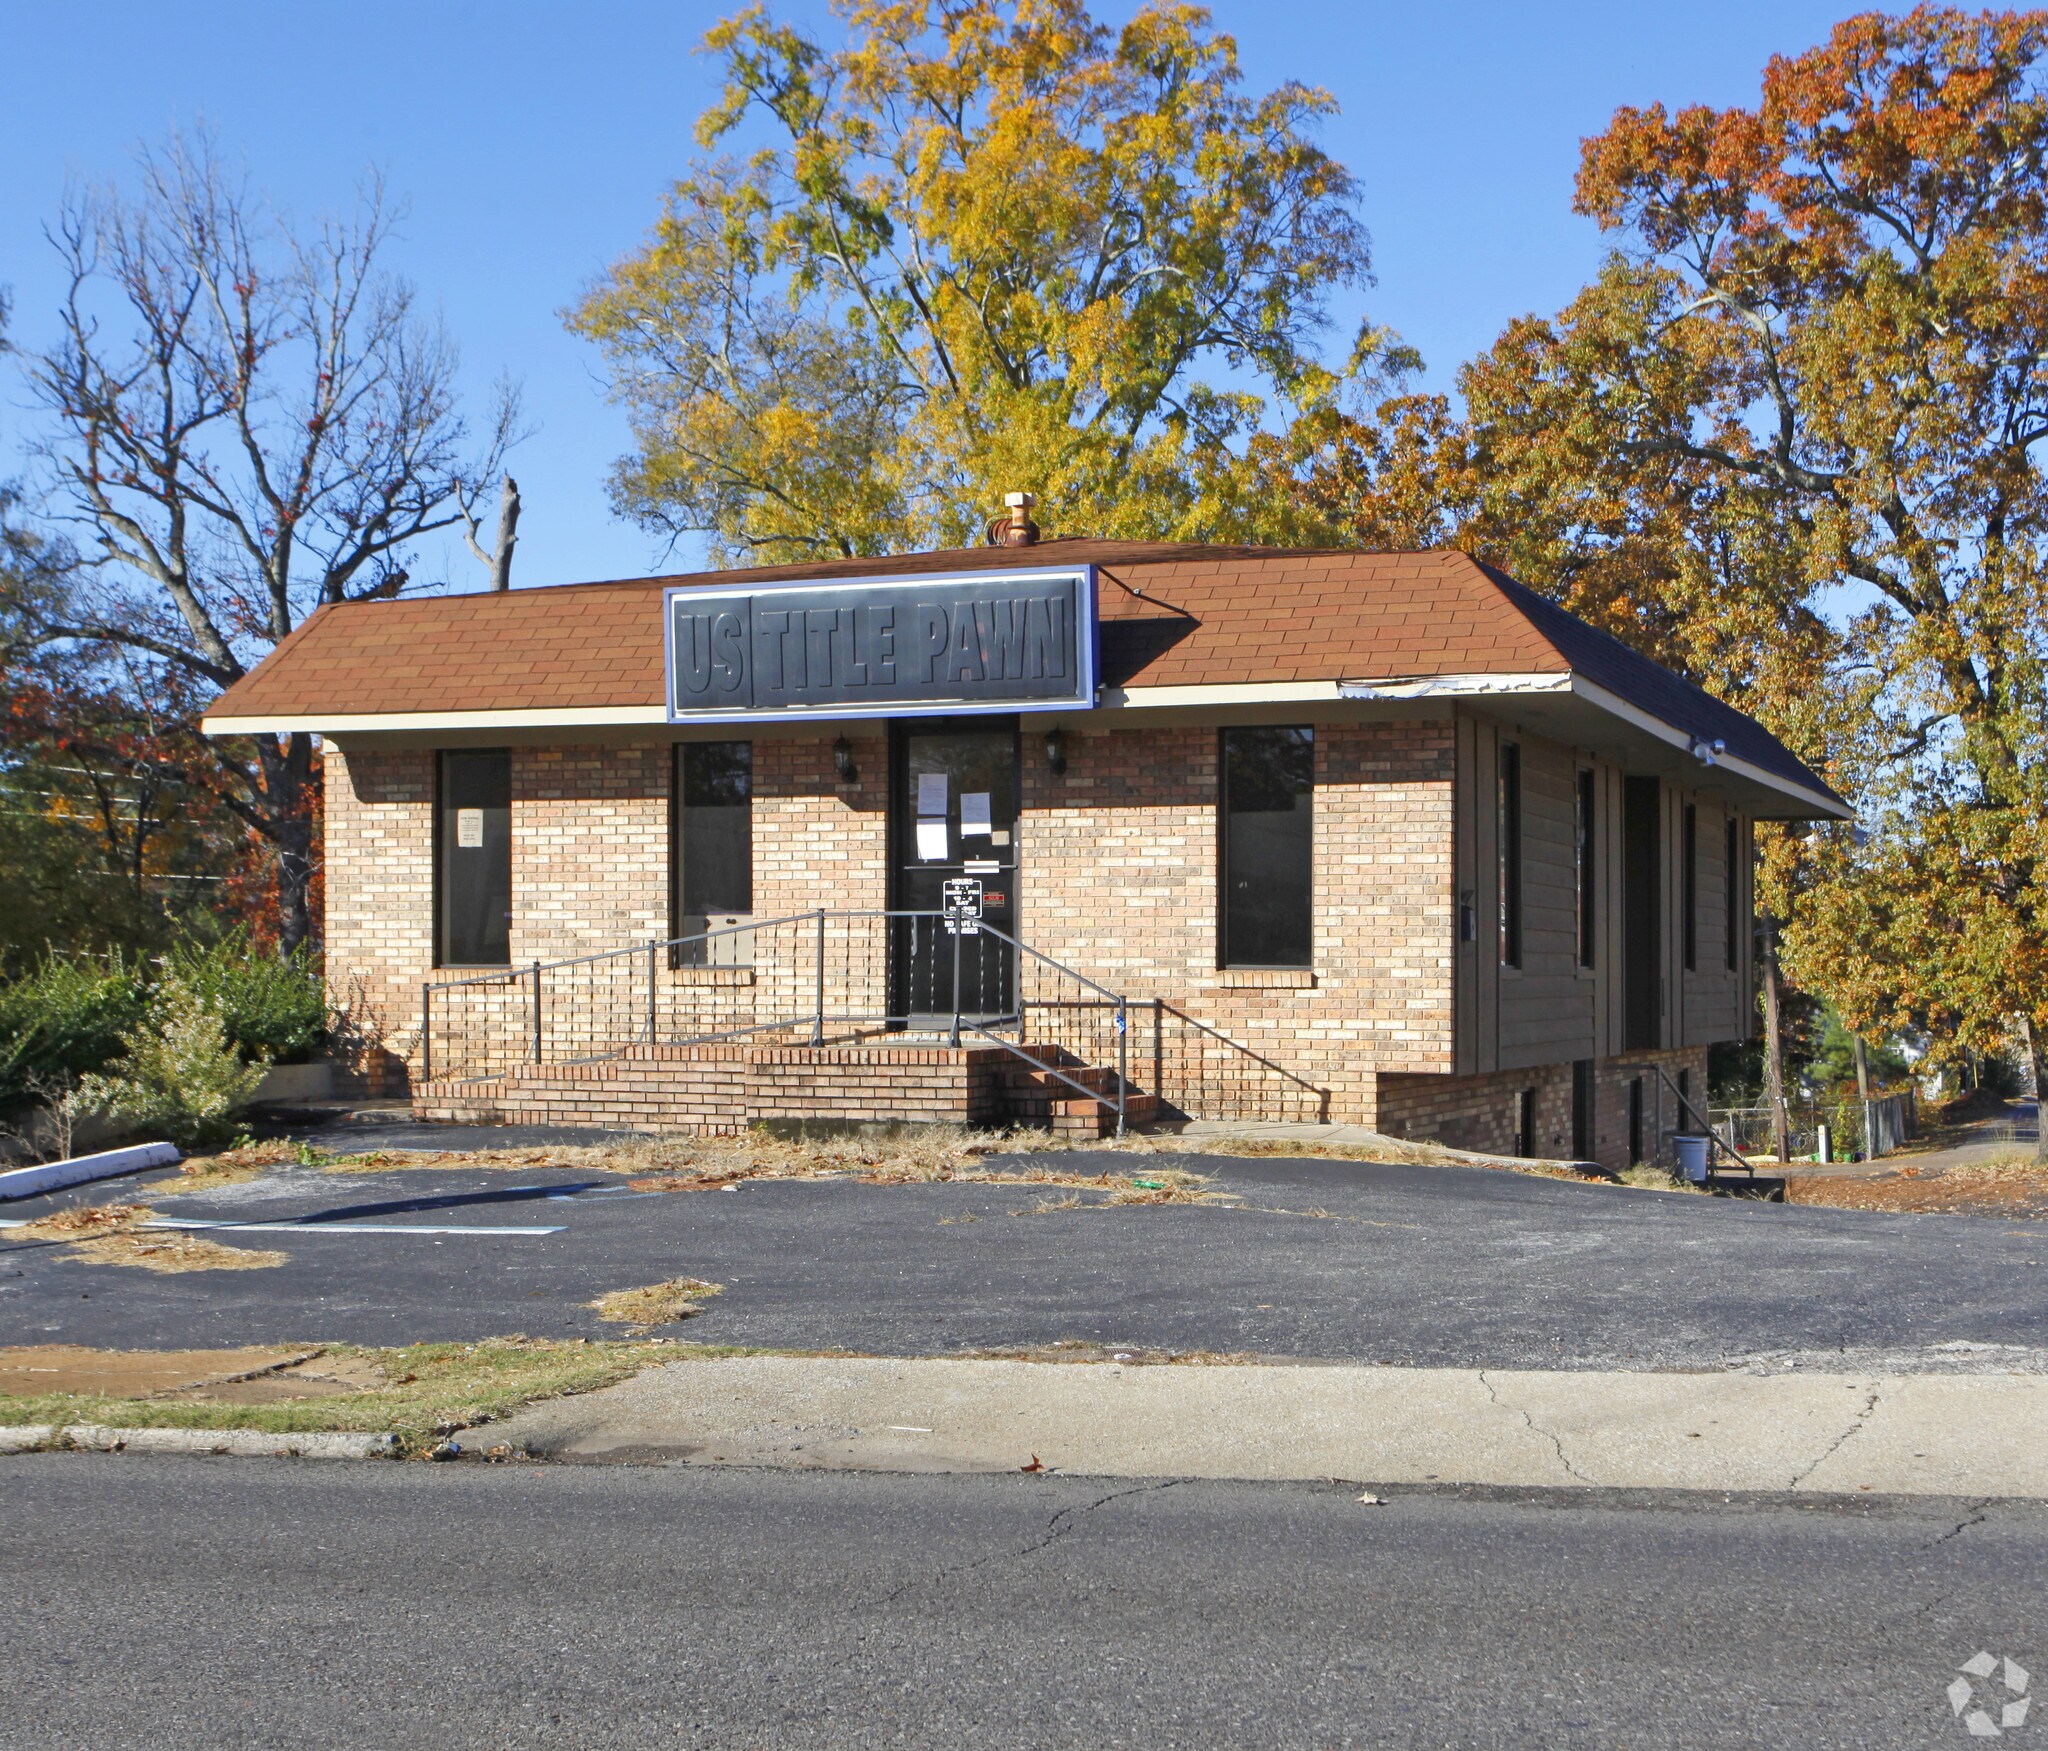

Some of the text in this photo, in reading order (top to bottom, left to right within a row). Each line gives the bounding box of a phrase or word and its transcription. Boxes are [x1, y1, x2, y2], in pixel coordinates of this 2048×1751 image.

[681, 597, 1066, 693] US TITLE PAWN
